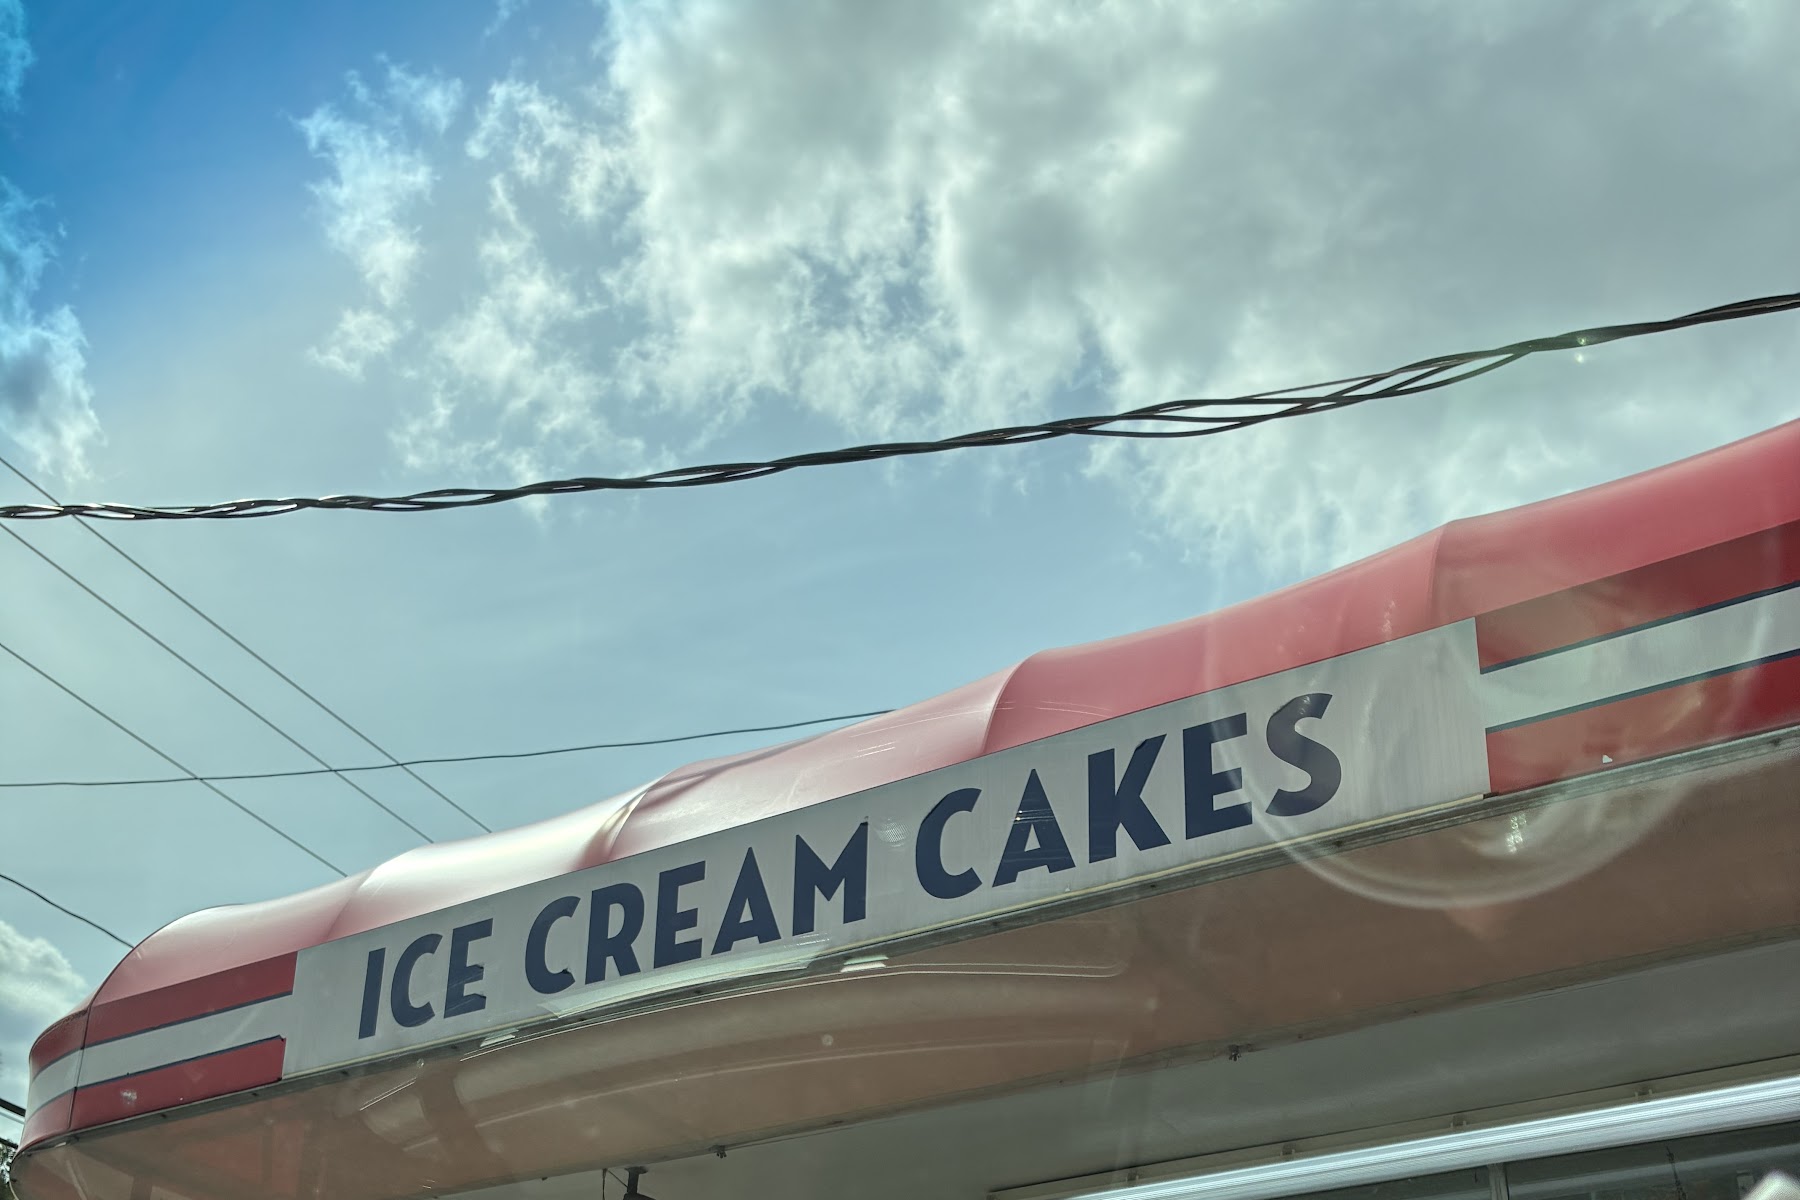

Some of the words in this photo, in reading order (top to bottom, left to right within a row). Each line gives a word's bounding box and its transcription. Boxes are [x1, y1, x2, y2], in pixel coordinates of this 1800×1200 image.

[359, 918, 493, 1039] ICE
[525, 818, 869, 994] CREAM
[915, 692, 1342, 900] CAKES
